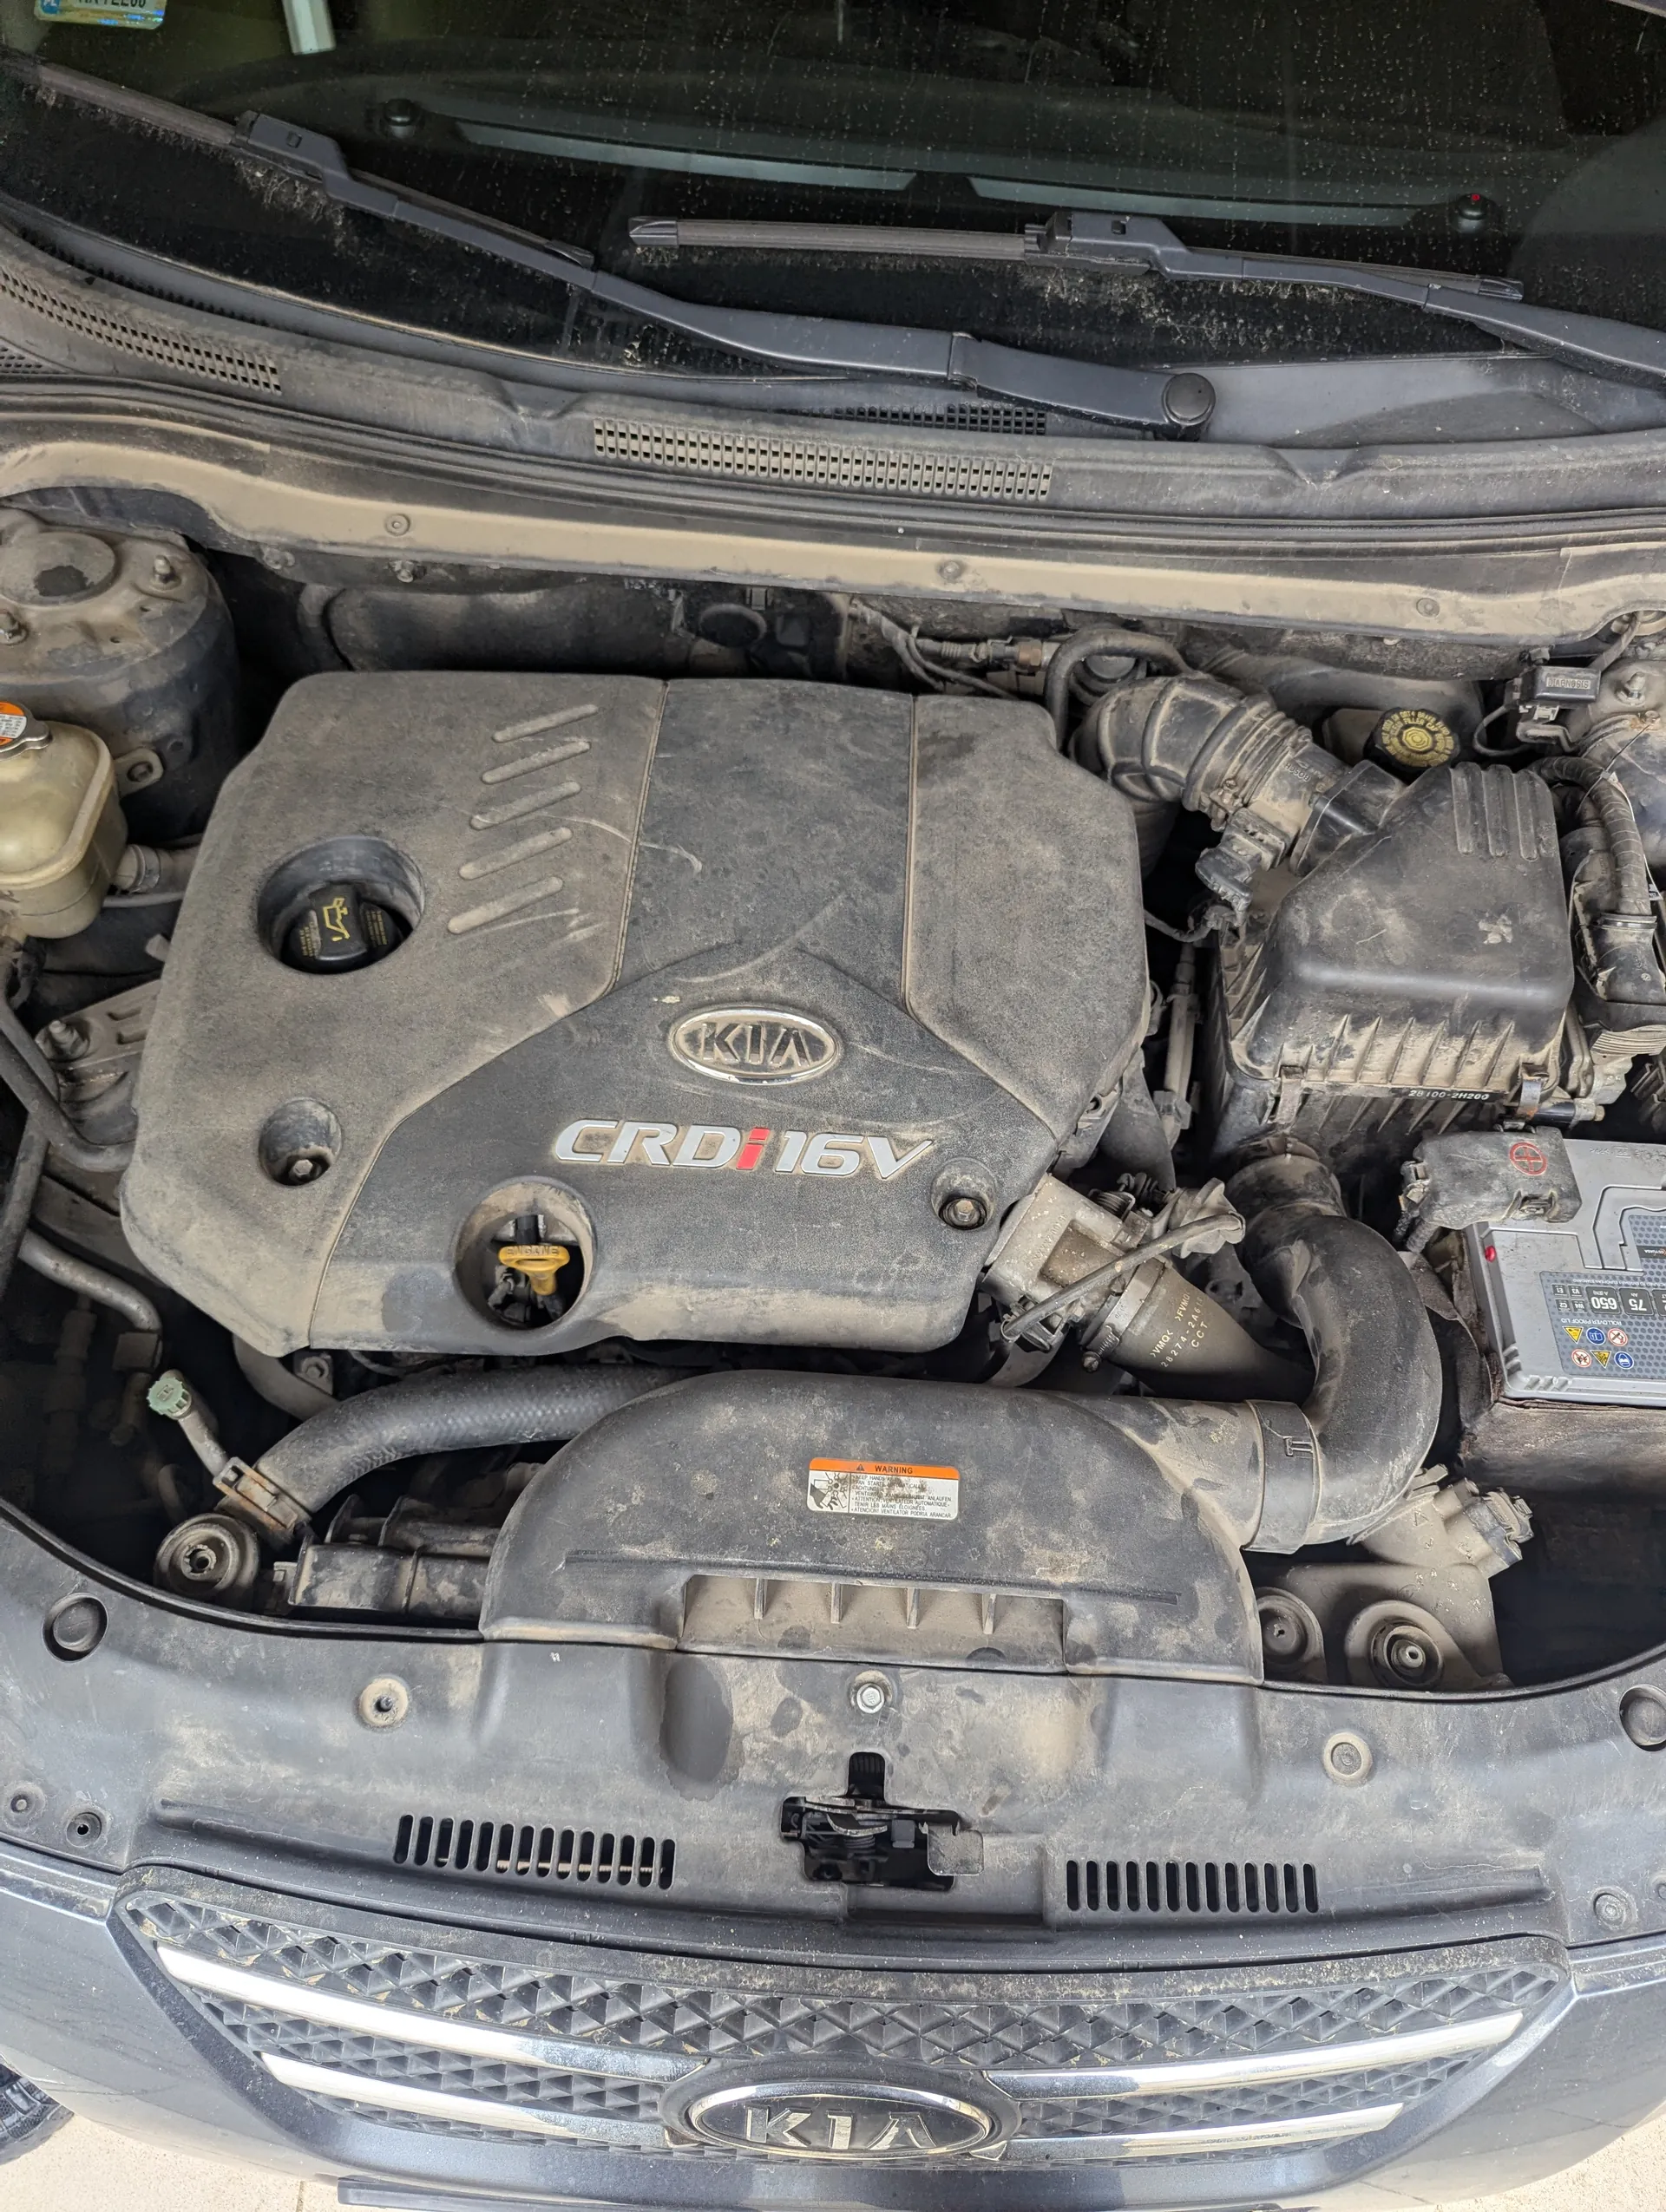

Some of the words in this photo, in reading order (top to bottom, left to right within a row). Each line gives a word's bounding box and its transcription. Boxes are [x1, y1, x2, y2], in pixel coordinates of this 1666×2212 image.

[1547, 678, 1590, 689] DIAGNOSIS
[1285, 762, 1311, 782] BOSCH
[701, 1021, 812, 1068] KIA
[1408, 1090, 1490, 1101] 28100-2H200
[507, 1246, 561, 1255] ENGINE
[1591, 1296, 1617, 1310] 650
[1629, 1299, 1647, 1312] 75
[875, 1464, 914, 1475] WARNING
[744, 2105, 941, 2152] KIA
